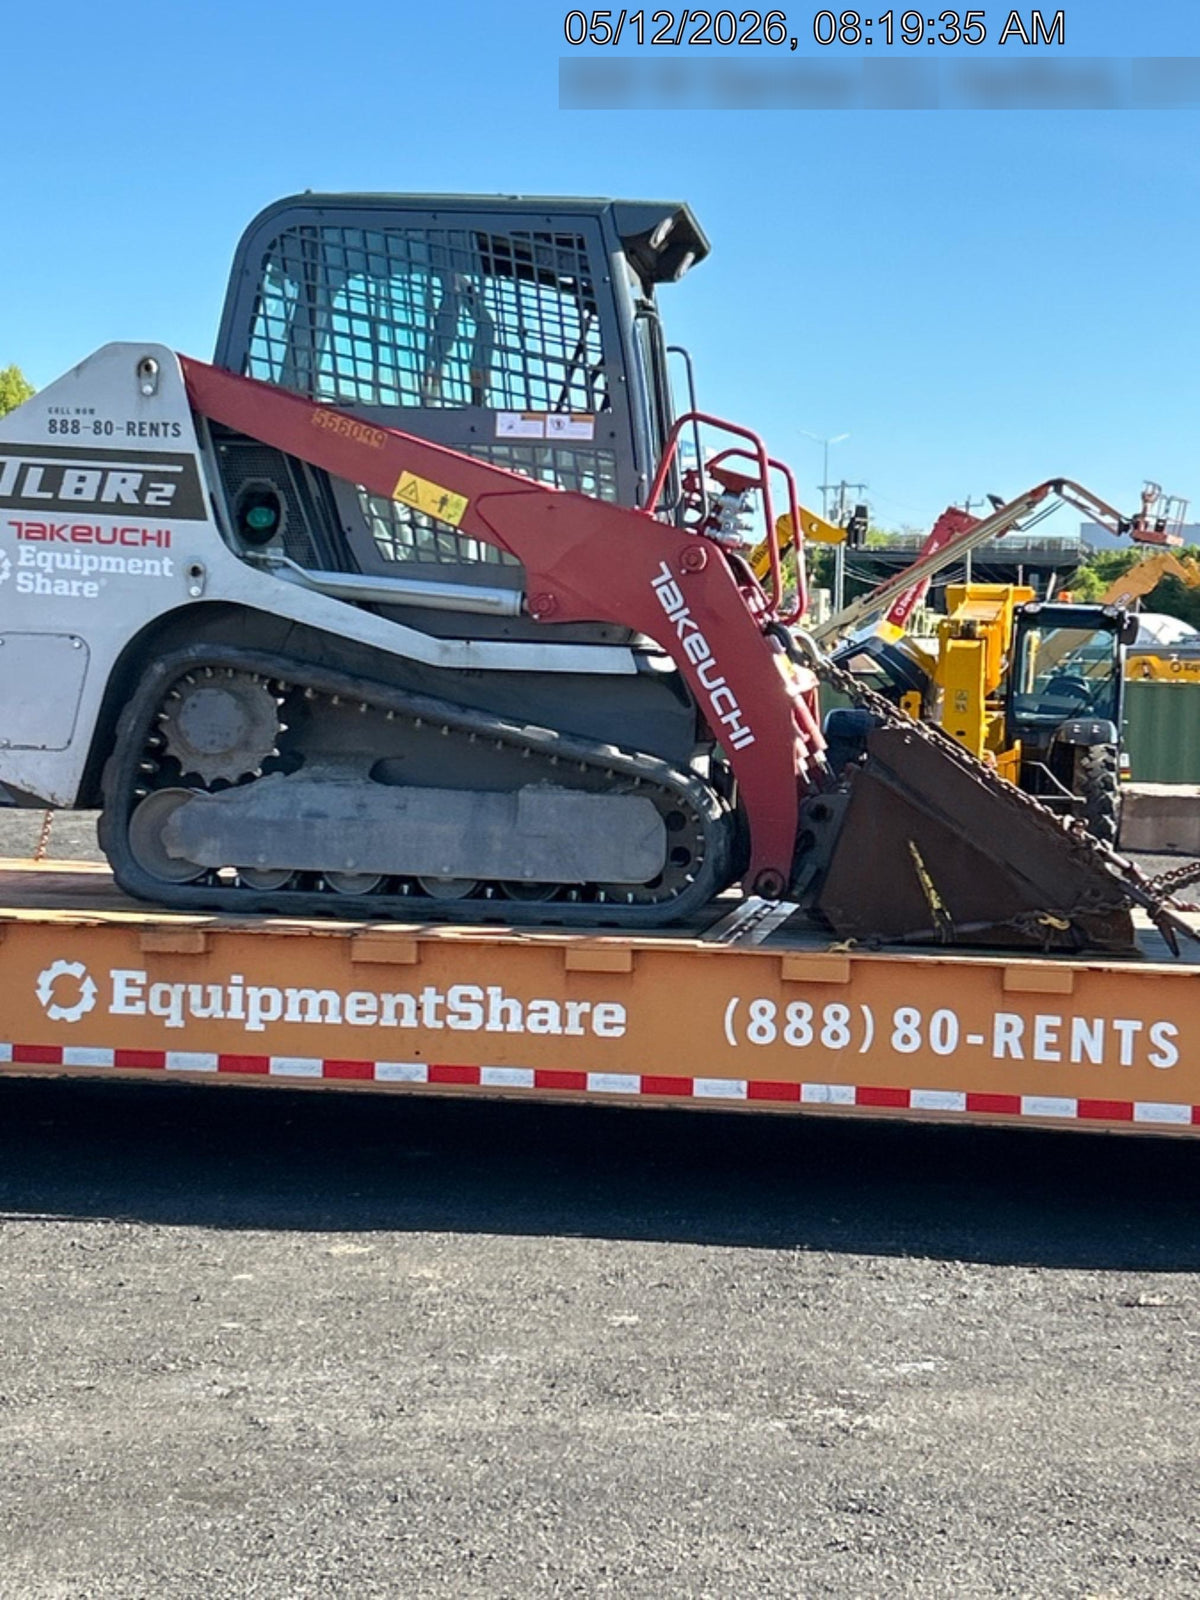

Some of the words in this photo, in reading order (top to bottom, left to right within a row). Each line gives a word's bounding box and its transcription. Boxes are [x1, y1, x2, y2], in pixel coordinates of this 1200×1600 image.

[48, 419, 181, 438] 888-80-RENTS
[17, 545, 174, 578] Equipment
[16, 571, 99, 598] Share
[109, 969, 627, 1038] EquipmentShare
[724, 997, 874, 1054] (888)
[891, 1007, 1179, 1069] 80-RENTS
